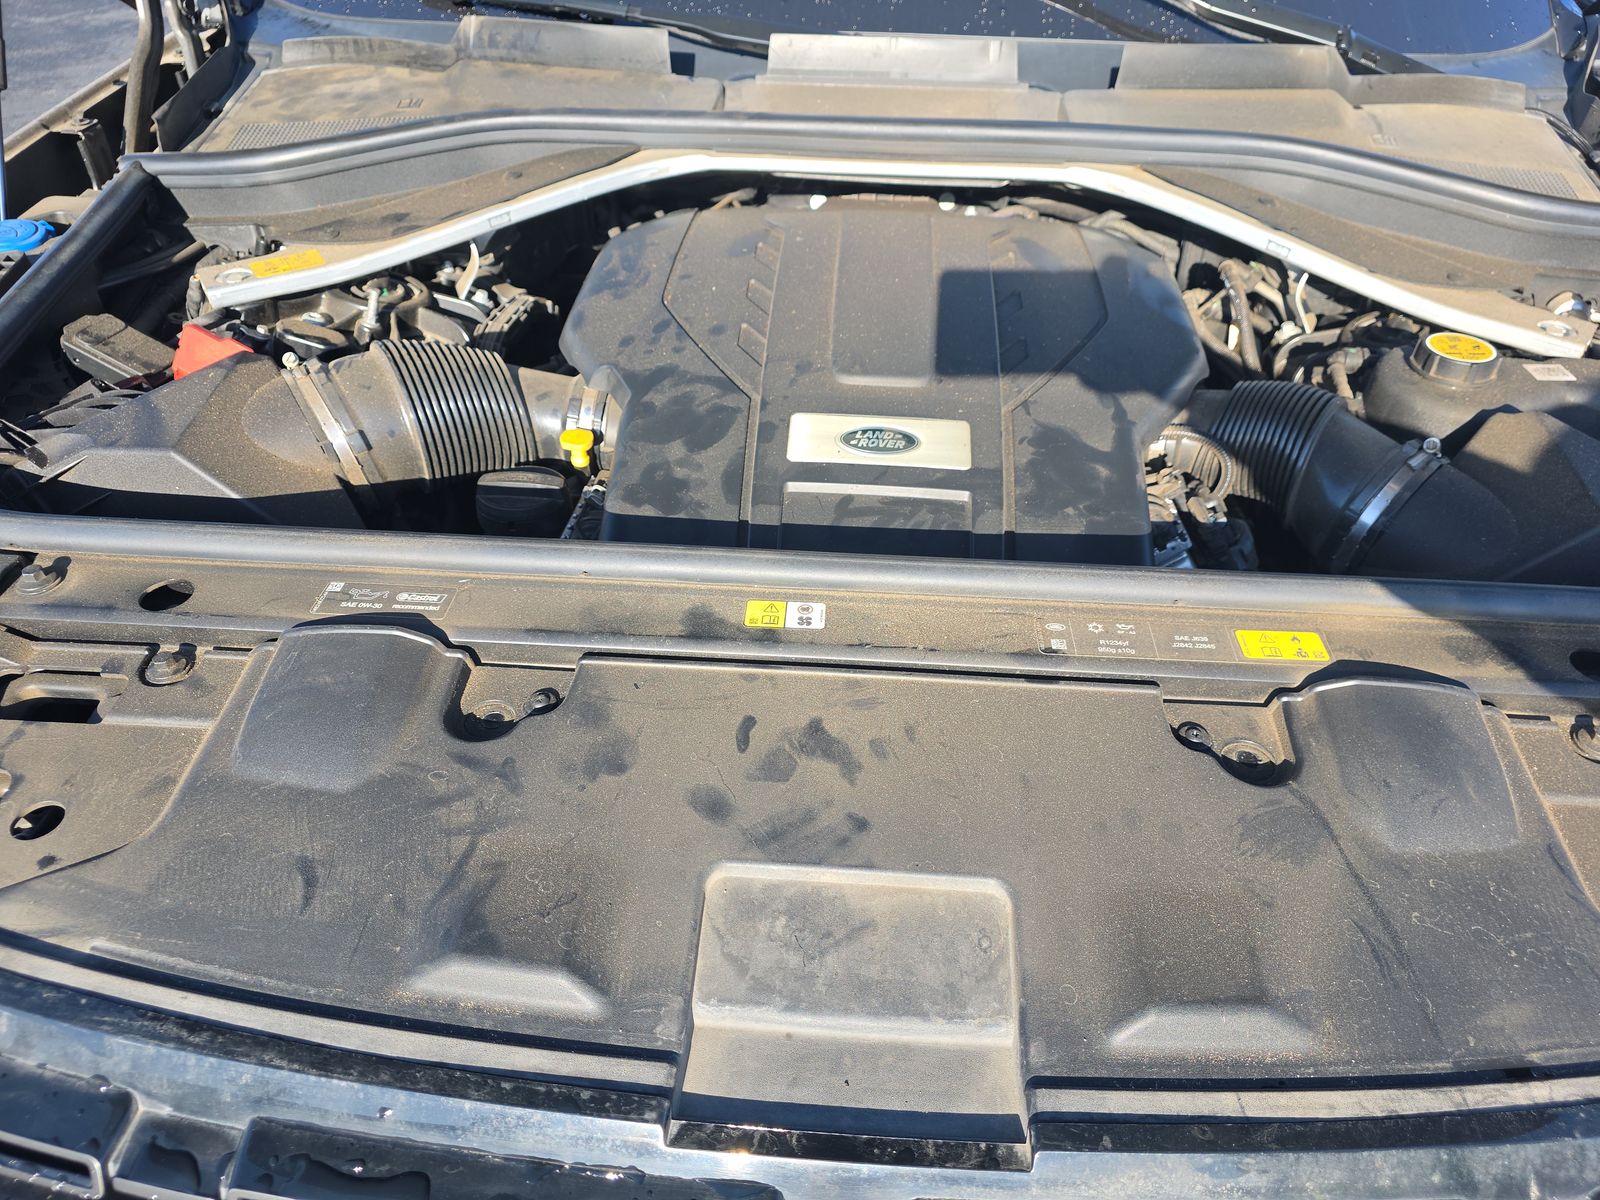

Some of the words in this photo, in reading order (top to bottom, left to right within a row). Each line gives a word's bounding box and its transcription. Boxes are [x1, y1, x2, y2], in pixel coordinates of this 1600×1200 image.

[855, 430, 894, 440] LAND
[857, 438, 906, 449] ROVER
[407, 594, 440, 602] Castrol
